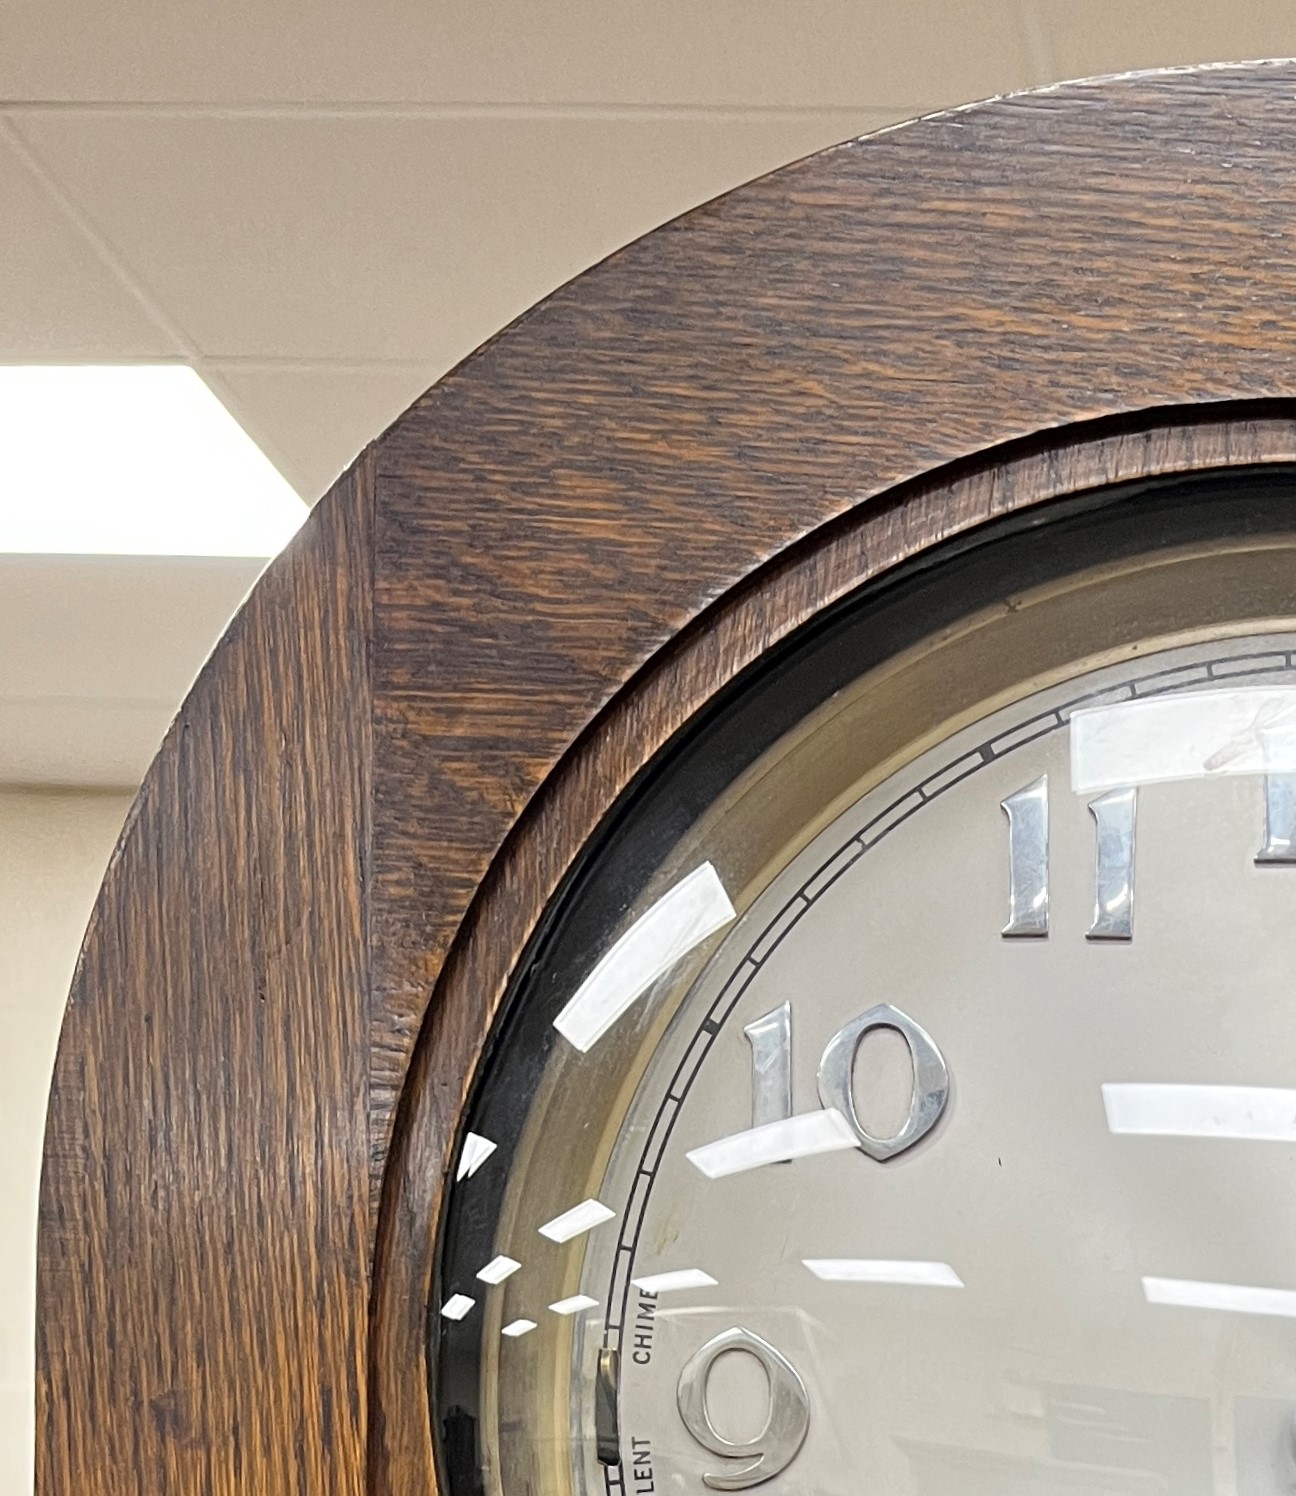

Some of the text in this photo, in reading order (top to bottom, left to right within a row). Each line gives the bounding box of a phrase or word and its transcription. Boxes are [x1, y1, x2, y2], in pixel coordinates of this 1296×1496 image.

[1000, 774, 1137, 940] 11
[744, 1000, 949, 1164] 10
[632, 1287, 659, 1365] CHIME
[676, 1326, 811, 1492] 9
